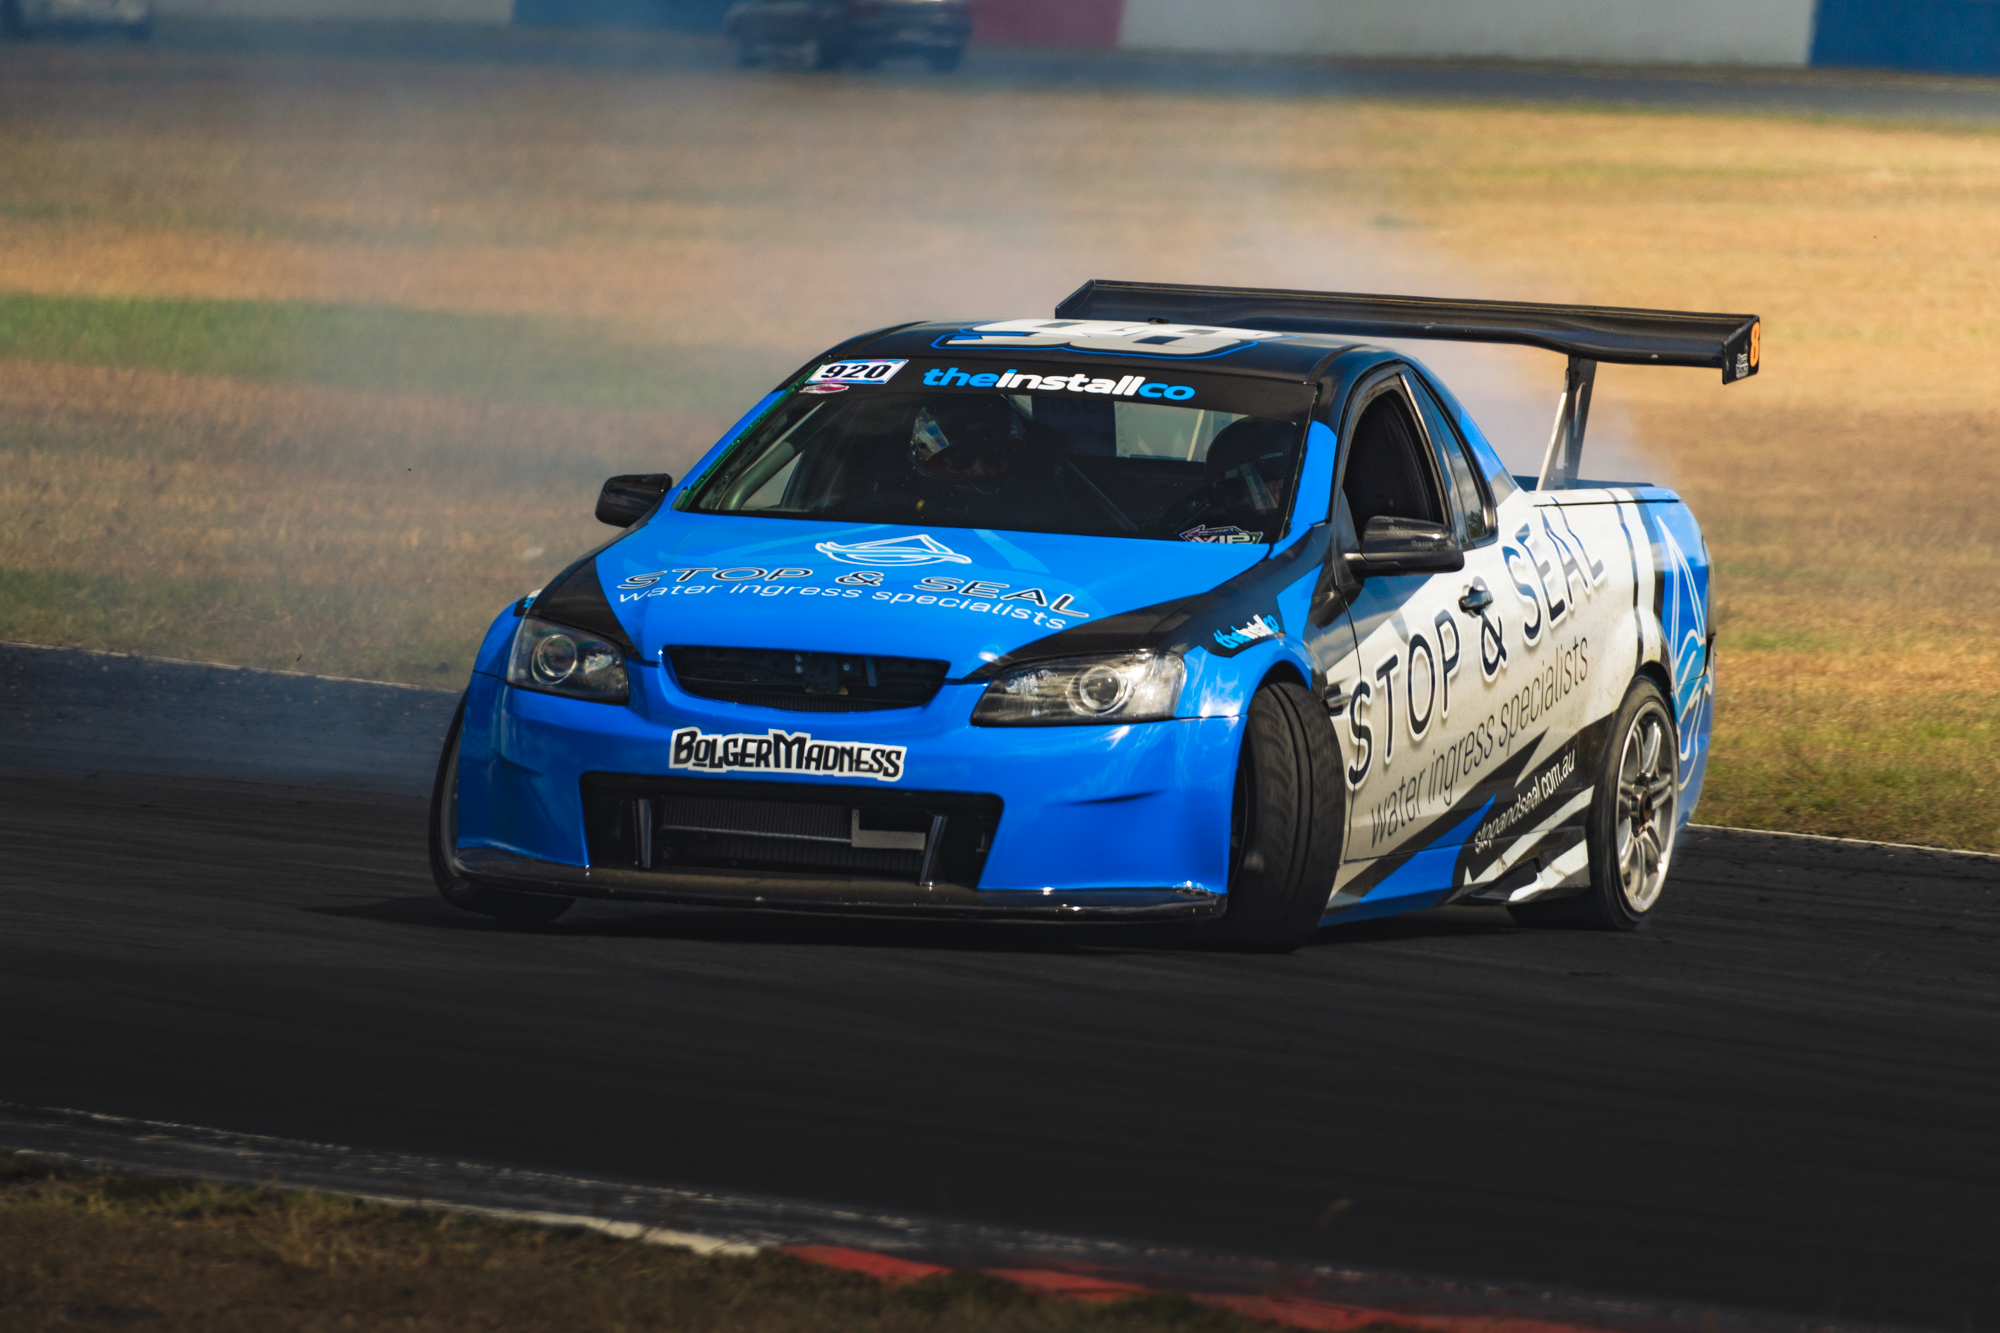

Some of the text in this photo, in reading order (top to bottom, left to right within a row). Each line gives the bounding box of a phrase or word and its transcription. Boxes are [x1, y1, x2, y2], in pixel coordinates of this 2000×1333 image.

[820, 364, 892, 378] 920
[922, 367, 1196, 400] theinstallco
[617, 566, 1090, 619] STOP & SEAL
[619, 581, 1067, 631] water ingress specialists
[1347, 496, 1606, 788] STOP & SEAL
[1371, 635, 1589, 849] water ingress specialists
[1474, 749, 1576, 855] stopandseal.com.au
